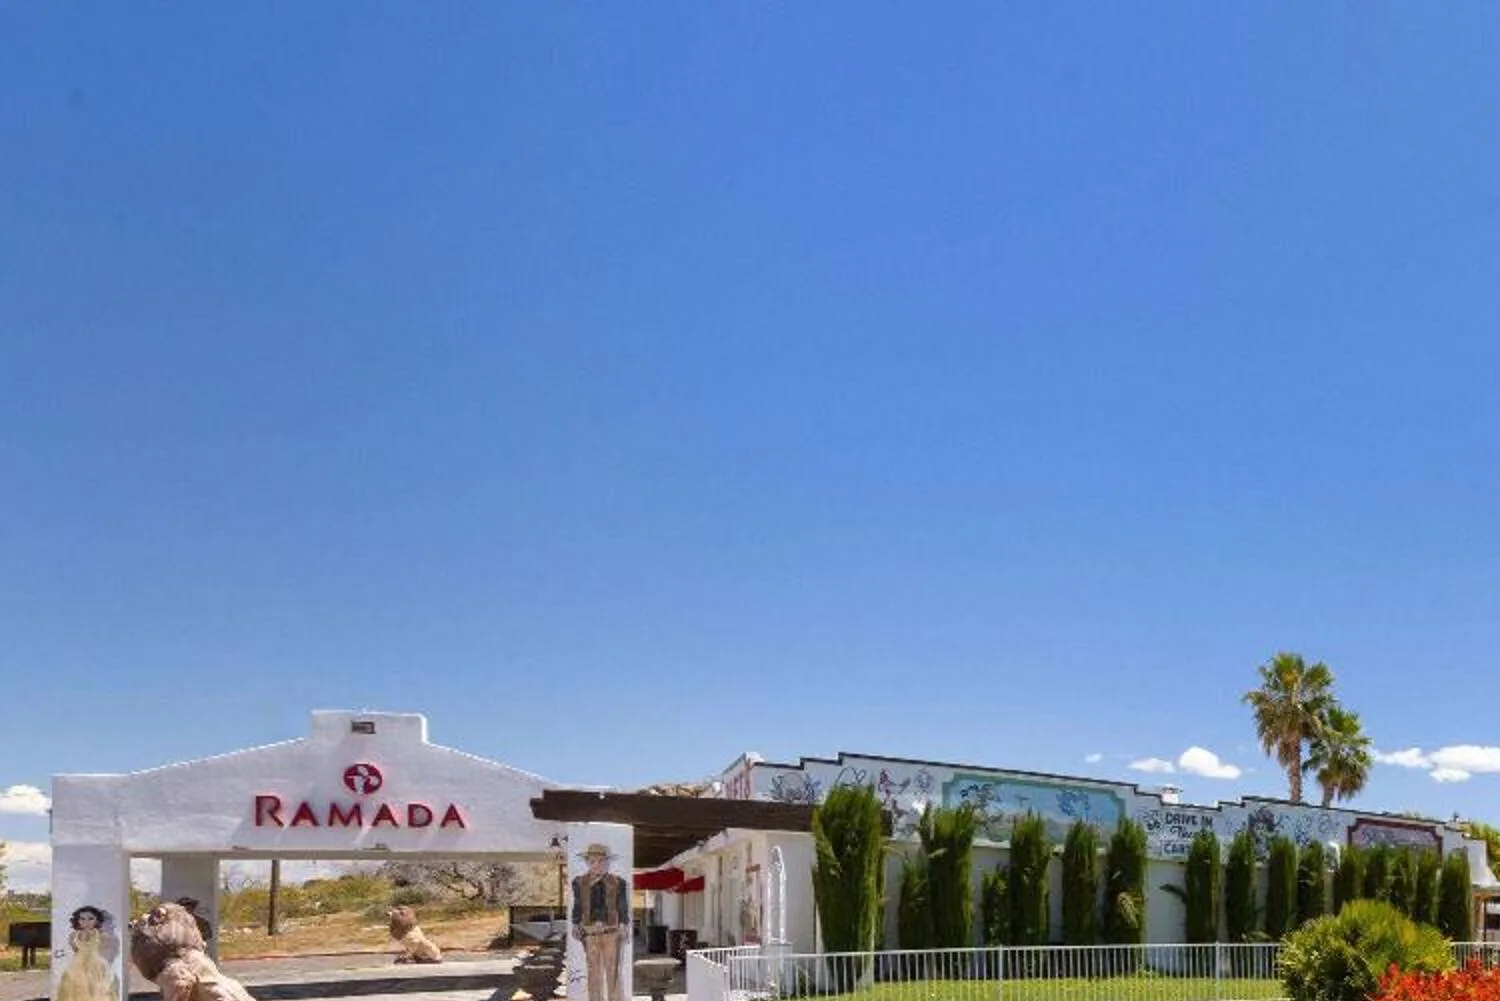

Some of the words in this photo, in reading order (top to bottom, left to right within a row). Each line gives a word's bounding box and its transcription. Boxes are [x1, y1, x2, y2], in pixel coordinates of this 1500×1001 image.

[255, 795, 465, 827] RAMADA
[1165, 811, 1198, 826] DRIVE
[1201, 814, 1213, 829] IN
